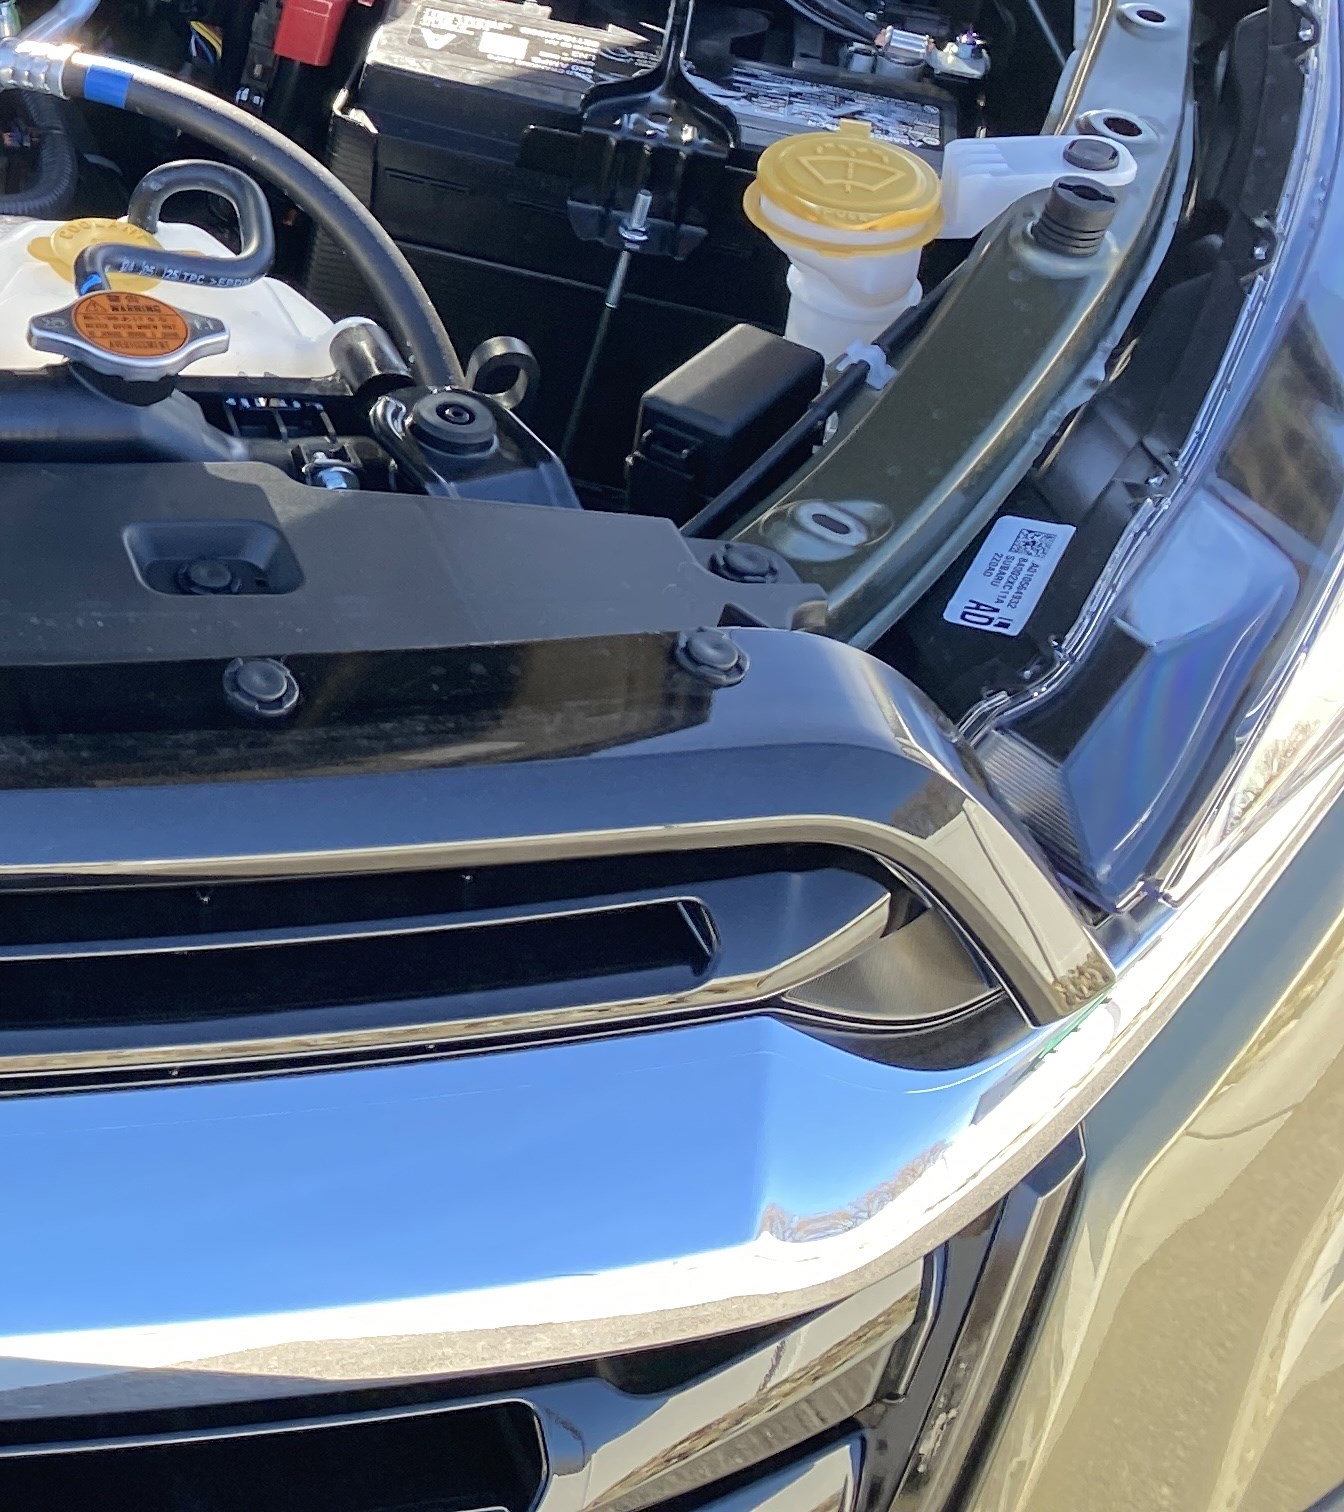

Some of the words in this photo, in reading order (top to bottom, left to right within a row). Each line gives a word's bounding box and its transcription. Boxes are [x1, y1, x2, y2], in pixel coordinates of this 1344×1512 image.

[58, 220, 146, 240] COOLANT
[990, 554, 1015, 587] SUBARU
[960, 599, 1001, 626] AD
